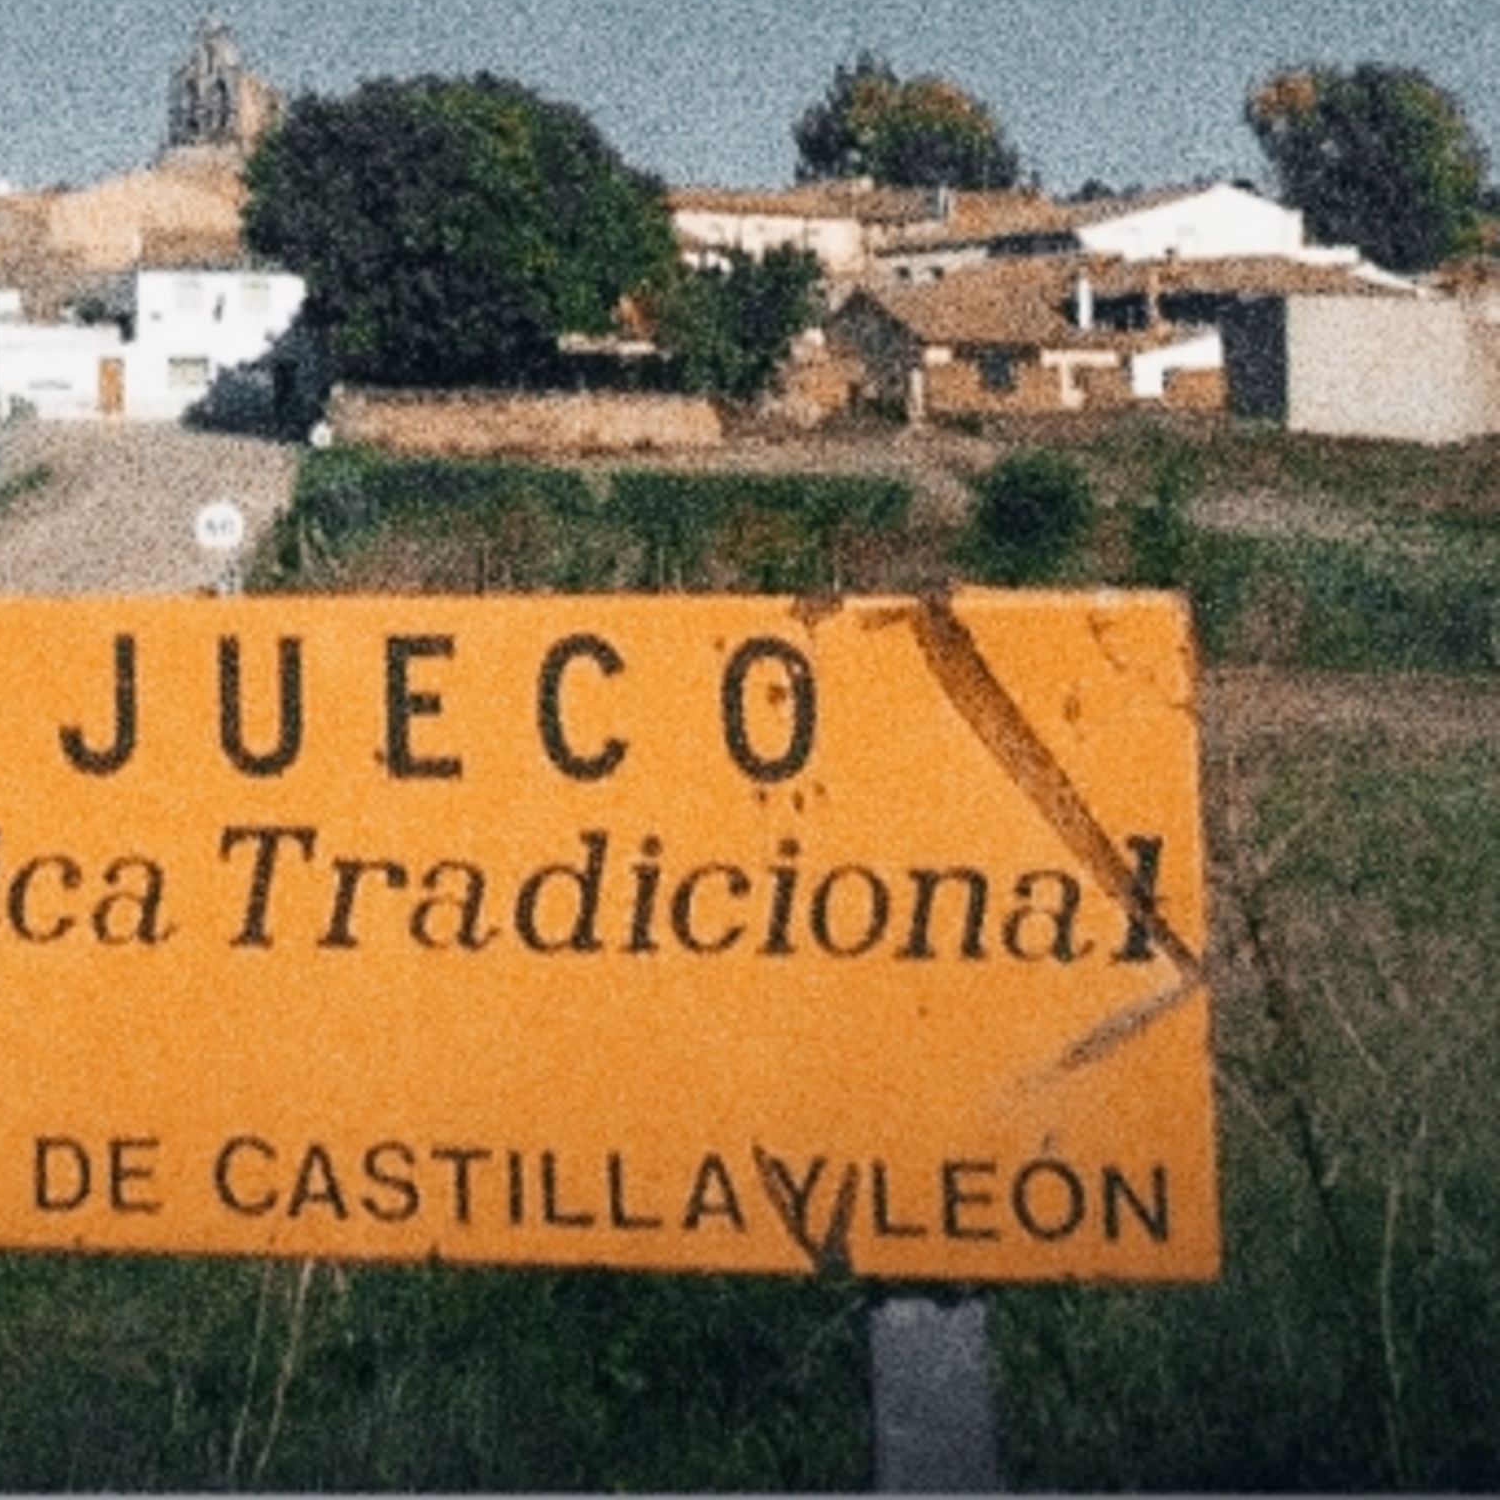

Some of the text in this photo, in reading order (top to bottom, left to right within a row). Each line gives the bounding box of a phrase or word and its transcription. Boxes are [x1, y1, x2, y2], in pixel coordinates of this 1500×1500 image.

[219, 825, 1166, 964] Tradicional
[36, 1138, 161, 1213] DE
[213, 1136, 747, 1230] CASTILLA
[764, 1155, 827, 1236] Y
[871, 1134, 1170, 1242] LEÓN
